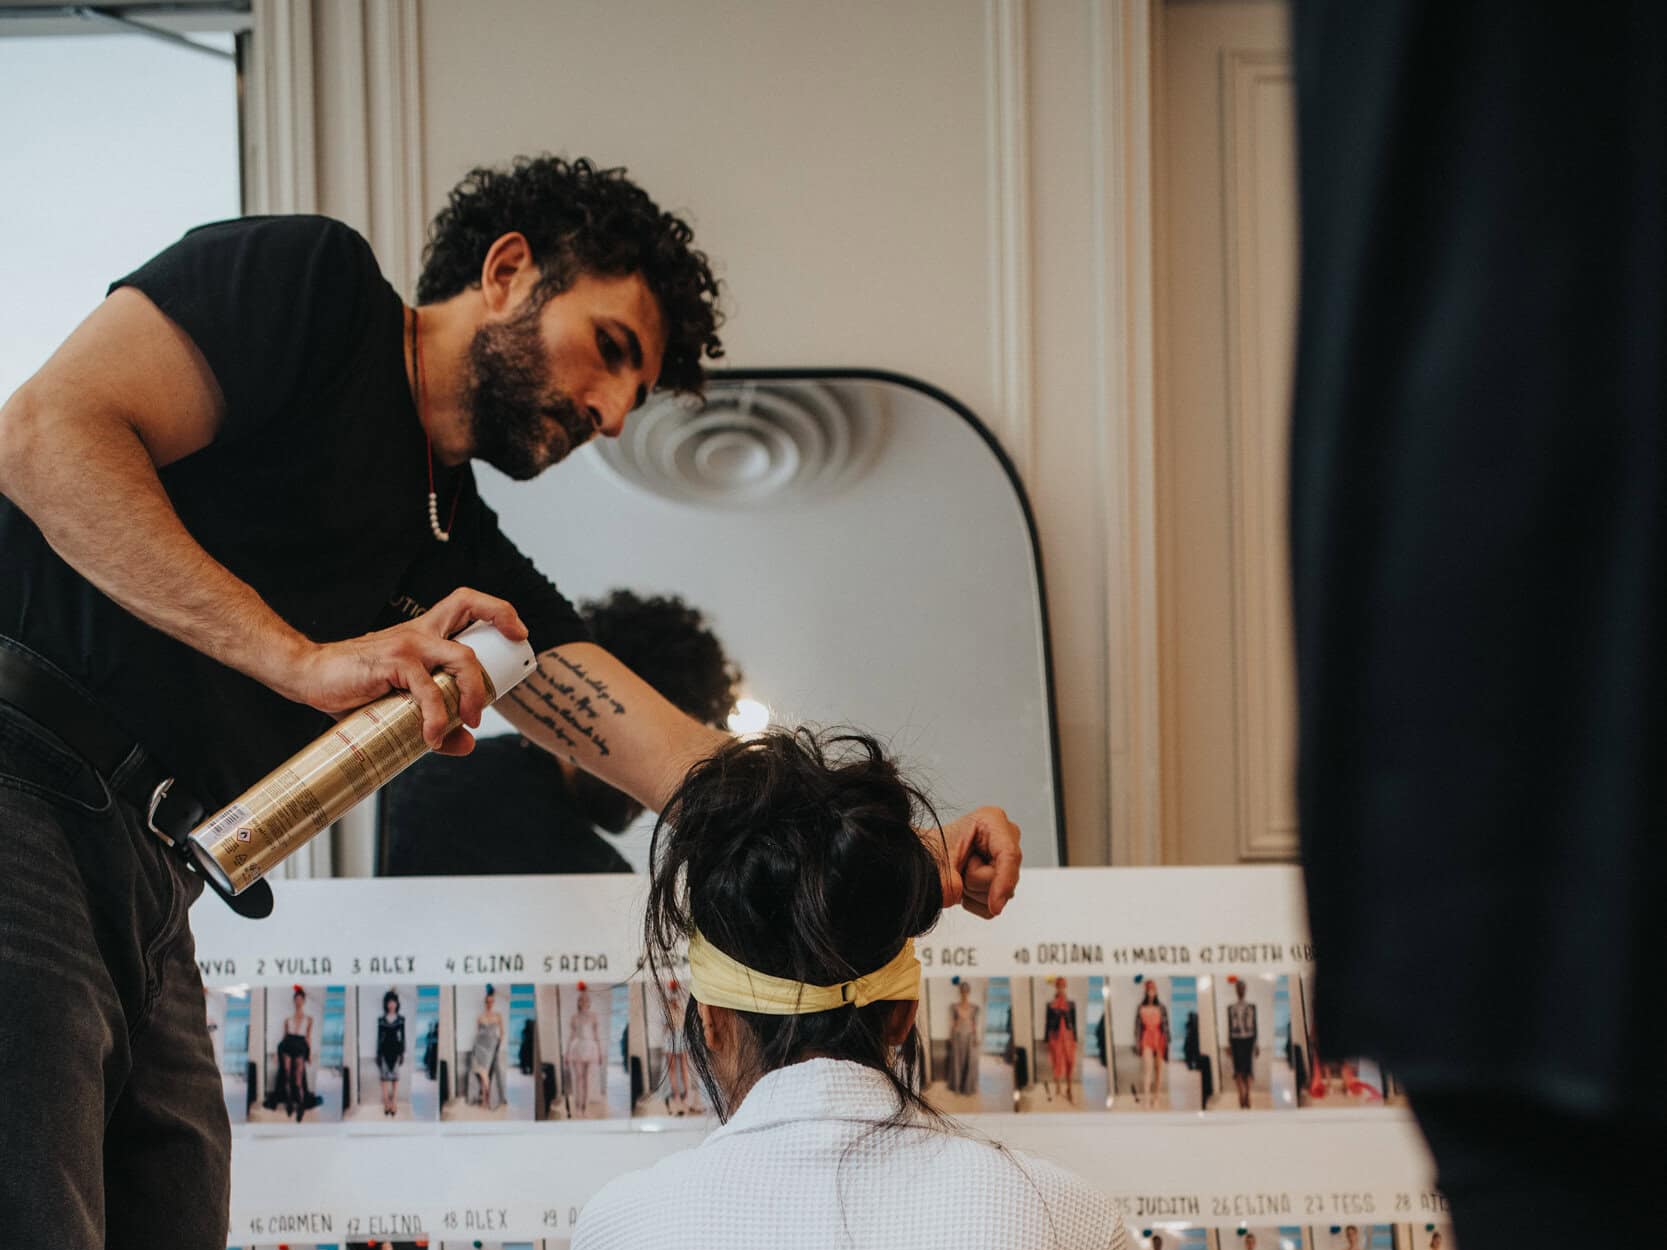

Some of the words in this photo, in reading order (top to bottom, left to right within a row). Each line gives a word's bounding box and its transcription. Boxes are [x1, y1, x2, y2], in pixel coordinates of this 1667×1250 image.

[543, 956, 553, 973] 5
[559, 953, 609, 973] AIDA
[922, 949, 933, 967] 9
[940, 947, 978, 967] ACE
[1034, 943, 1104, 964] ORIANA
[1132, 945, 1191, 964] MARIA
[1217, 943, 1283, 963] JUDITH
[256, 959, 266, 975] 2
[274, 957, 332, 975] YULIA
[352, 958, 362, 974] 3
[369, 956, 415, 974] ALEX
[445, 959, 455, 973] 4
[463, 954, 524, 974] ELINA
[1137, 1195, 1200, 1216] JUDITH
[1212, 1197, 1231, 1217] 26
[1233, 1193, 1291, 1217] ELINA
[1331, 1192, 1377, 1216] TESS
[269, 1213, 333, 1233] CARMEN
[369, 1214, 423, 1234] ELINA
[465, 1209, 508, 1230] ALEX
